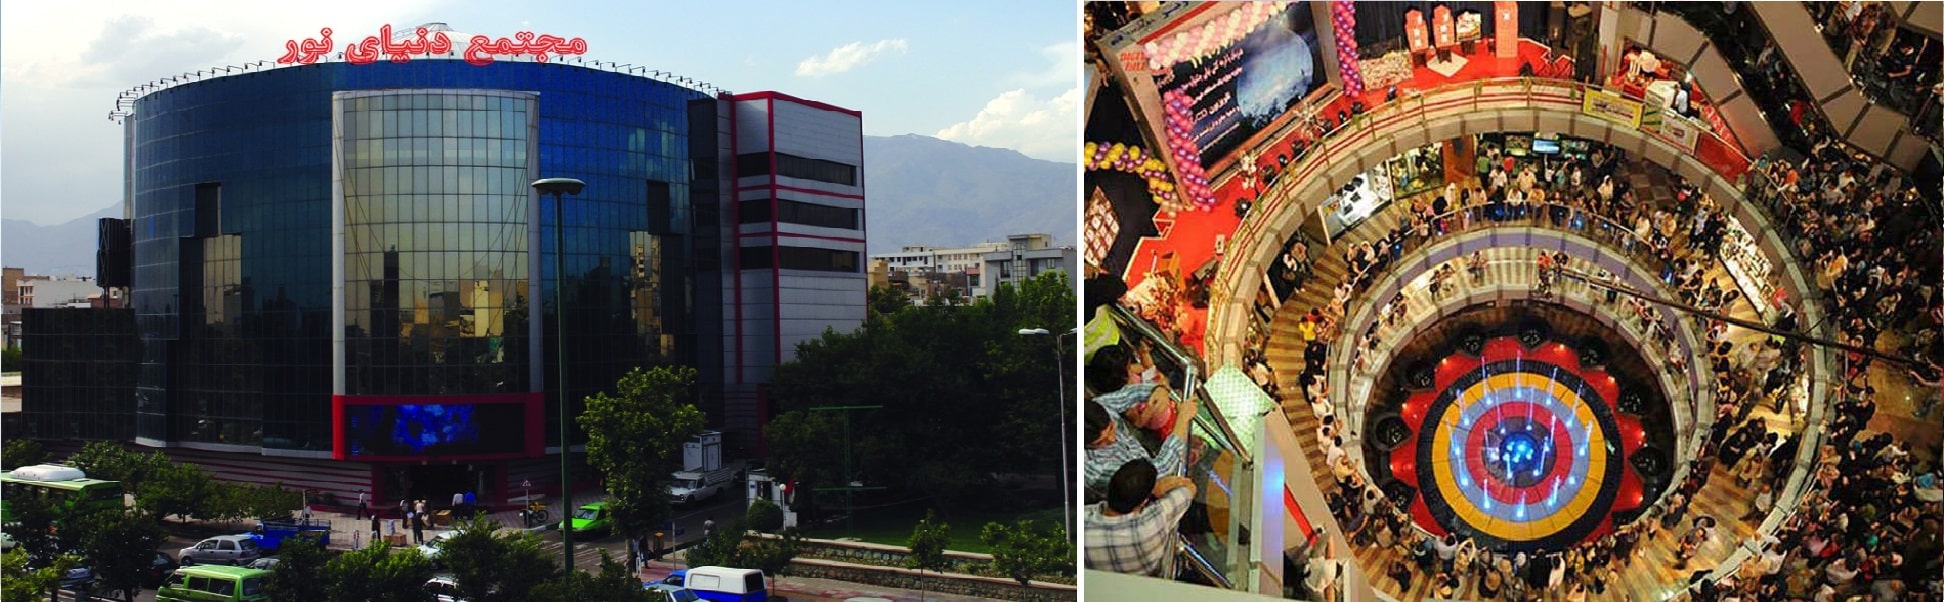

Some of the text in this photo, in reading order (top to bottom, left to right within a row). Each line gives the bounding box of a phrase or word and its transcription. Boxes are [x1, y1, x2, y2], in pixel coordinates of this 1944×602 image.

[277, 24, 587, 65] مجتمع دنیای نور
